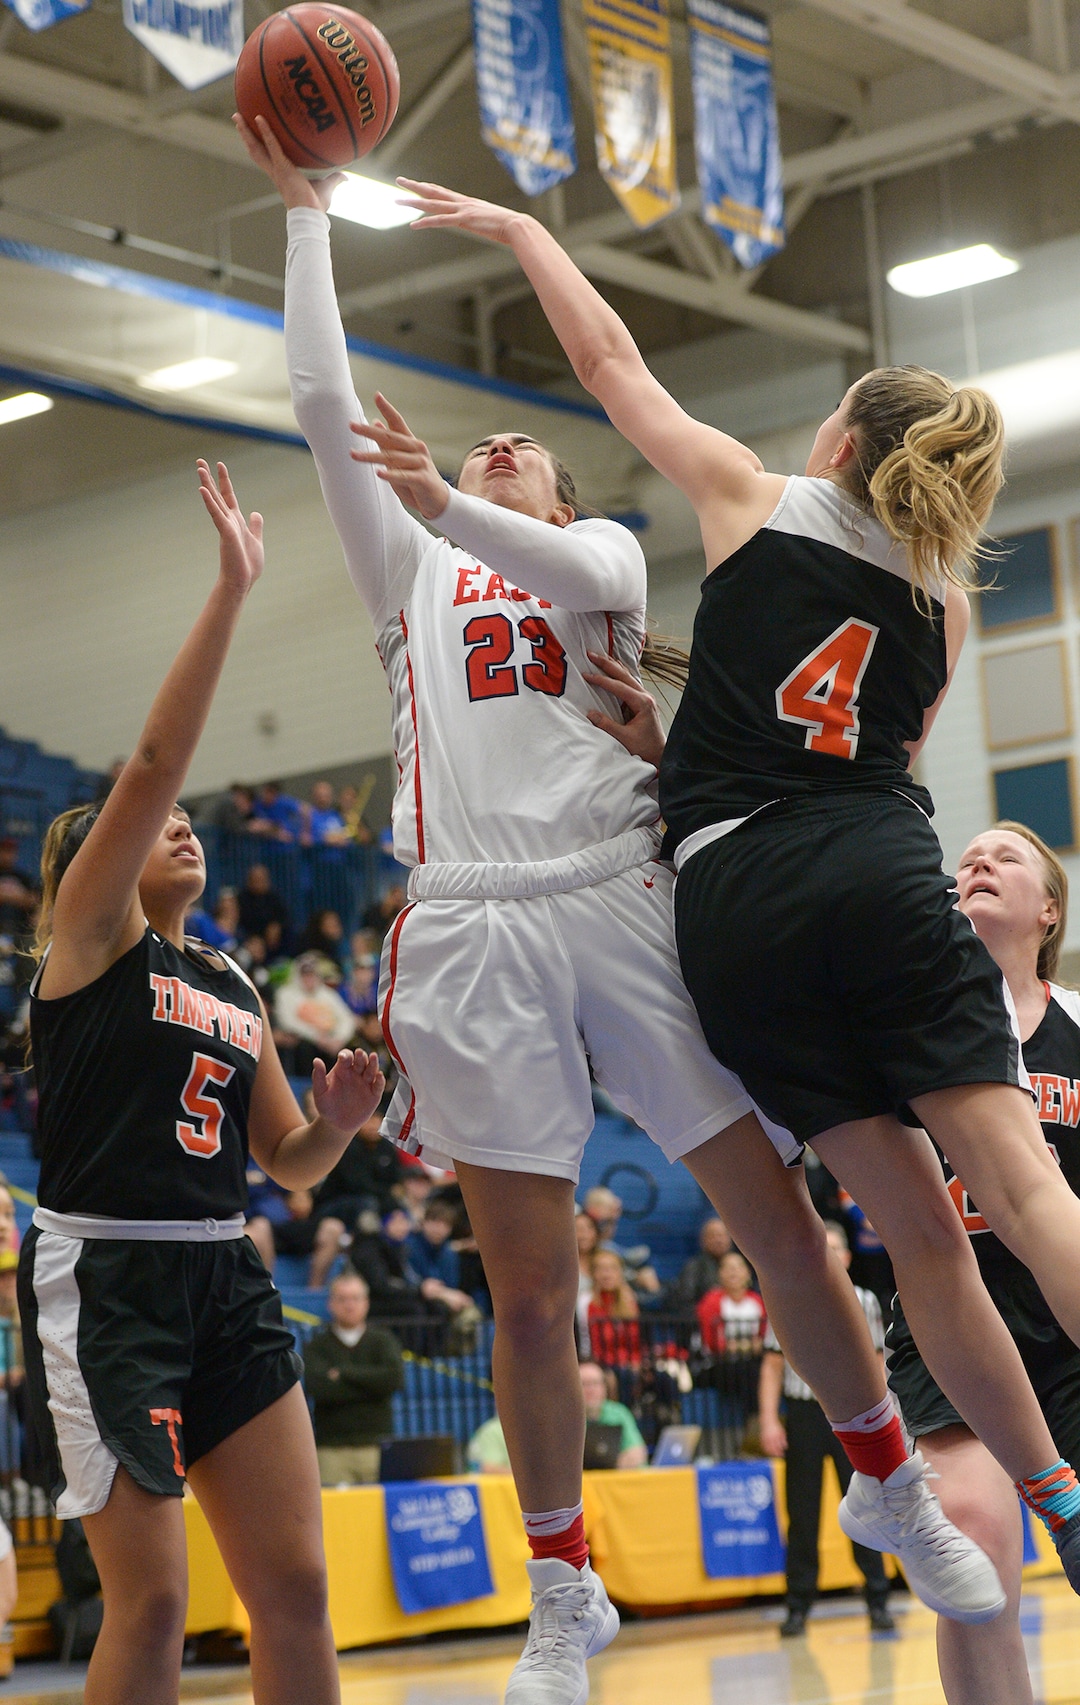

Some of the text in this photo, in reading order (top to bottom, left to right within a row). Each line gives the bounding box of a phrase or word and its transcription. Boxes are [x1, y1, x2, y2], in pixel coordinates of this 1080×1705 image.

[284, 54, 336, 133] NCAA
[316, 17, 377, 129] Wilson
[453, 565, 552, 607] EA
[463, 612, 568, 703] 23
[775, 616, 880, 761] 4
[149, 972, 263, 1063] TIMPVIEW
[176, 1051, 237, 1160] 5
[149, 1407, 186, 1477] T
